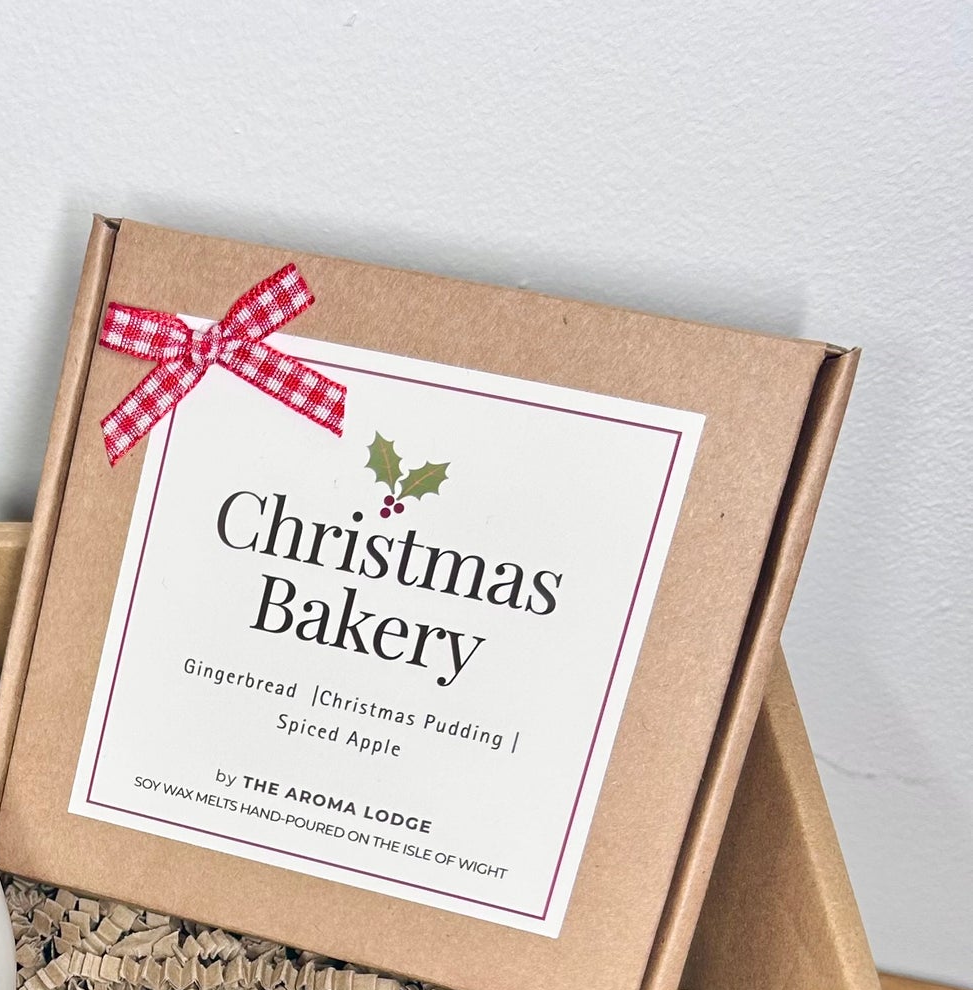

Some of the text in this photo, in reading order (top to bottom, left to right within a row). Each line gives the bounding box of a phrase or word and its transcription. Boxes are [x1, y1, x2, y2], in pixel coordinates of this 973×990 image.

[216, 490, 563, 616] Christmas
[249, 573, 487, 687] Bakery
[184, 658, 298, 698] Gingerbread
[423, 713, 503, 751] Pudding
[276, 713, 401, 757] Spiced Apple
[133, 776, 509, 880] SOY WAX MELTS HAND-POURED ON THE ISLE OF WIGHT
[215, 768, 432, 834] by THE AROMA LODGE
